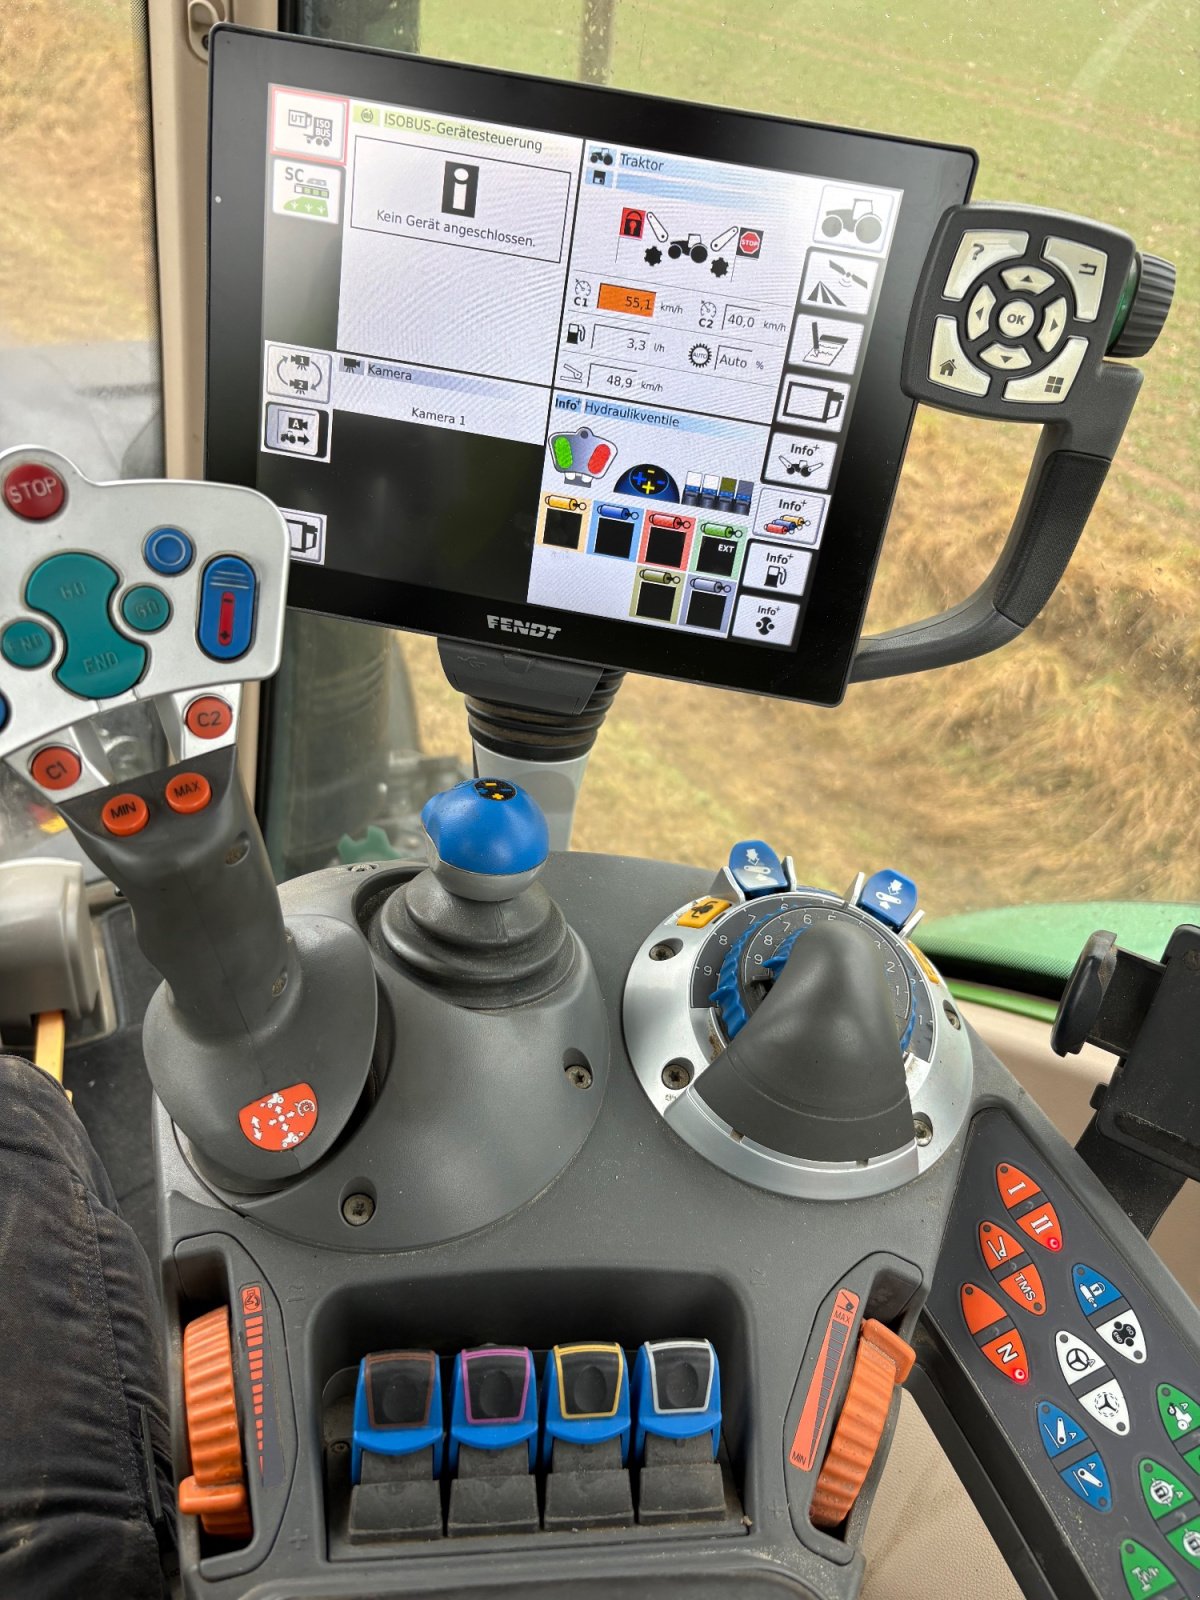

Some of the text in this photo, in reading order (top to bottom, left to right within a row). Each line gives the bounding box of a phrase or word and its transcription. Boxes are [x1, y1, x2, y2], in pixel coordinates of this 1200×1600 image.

[291, 114, 304, 123] UT
[384, 112, 542, 154] ISOBUS-Gerätesteuerung
[619, 152, 664, 173] Traktor
[285, 166, 304, 182] SC
[376, 209, 536, 247] Kein Gerät angeschlossen.
[741, 239, 759, 247] STOP
[573, 295, 683, 315] C1 55,1 km/h
[698, 315, 787, 332] C2 40,0 km/h
[1007, 313, 1026, 325] OK
[627, 338, 646, 351] 3,3
[719, 353, 748, 369] Auto
[755, 360, 764, 370] %
[367, 363, 412, 381] Kamera
[606, 374, 664, 393] 48,9 km/h
[411, 406, 466, 426] Kamera 1
[585, 399, 680, 428] Hydraulikventile
[7, 478, 57, 504] STOP
[718, 544, 734, 554] EXT
[486, 614, 562, 640] FENDT
[83, 651, 118, 675] END
[197, 711, 222, 727] C2
[45, 761, 67, 780] C1
[173, 781, 201, 799] MAX
[110, 801, 137, 820] MIN
[783, 922, 791, 933] 7
[803, 914, 812, 924] 6
[719, 935, 728, 946] 8
[764, 935, 773, 946] 8
[754, 954, 763, 965] 9
[886, 961, 896, 973] 2
[703, 965, 713, 976] 9
[1014, 1272, 1037, 1302] TMS
[833, 1311, 850, 1324] MAX
[1125, 1324, 1135, 1336] GO
[997, 1341, 1020, 1364] N
[791, 1452, 806, 1466] MIN
